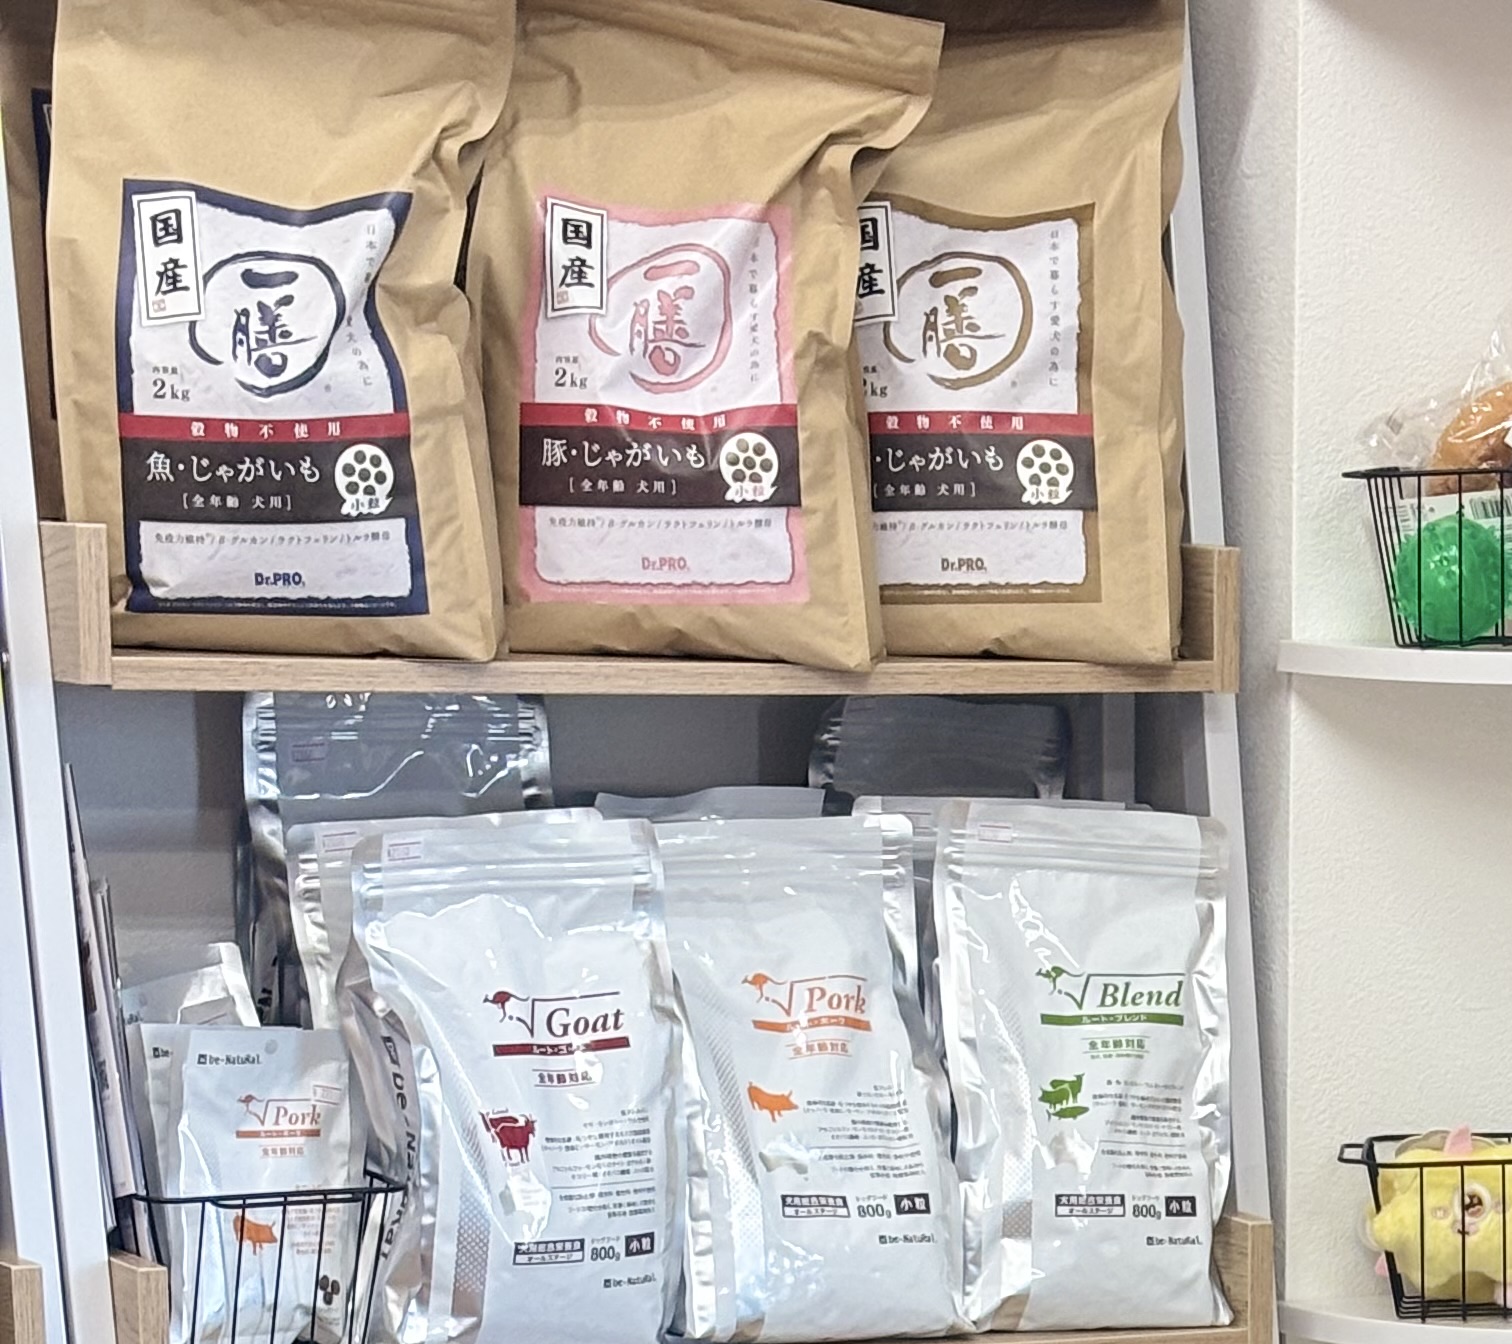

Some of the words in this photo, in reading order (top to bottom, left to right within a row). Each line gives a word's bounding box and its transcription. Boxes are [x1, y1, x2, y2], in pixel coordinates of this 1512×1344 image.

[150, 208, 190, 297] 国産
[558, 217, 596, 290] 国産
[858, 216, 886, 298] 国産
[231, 268, 319, 379] 一膳
[628, 259, 706, 377] 一膳
[921, 265, 1006, 371] 一膳
[152, 378, 191, 402] 2kg
[554, 366, 588, 390] 2kg
[190, 420, 342, 439] 穀物不使用
[584, 407, 727, 431] 穀物不使用
[886, 413, 1025, 431] 穀物不使用
[146, 450, 321, 484] 魚・じゃがいも
[541, 437, 706, 469] 豚・じゃがいも
[875, 445, 1004, 472] ・じゃがいも
[804, 984, 867, 1014] Pork
[1096, 980, 1184, 1009] Blend
[545, 1007, 625, 1039] Goat
[272, 1103, 322, 1127] Pork
[1132, 1203, 1162, 1220] 800g
[590, 1245, 621, 1262] 800g
